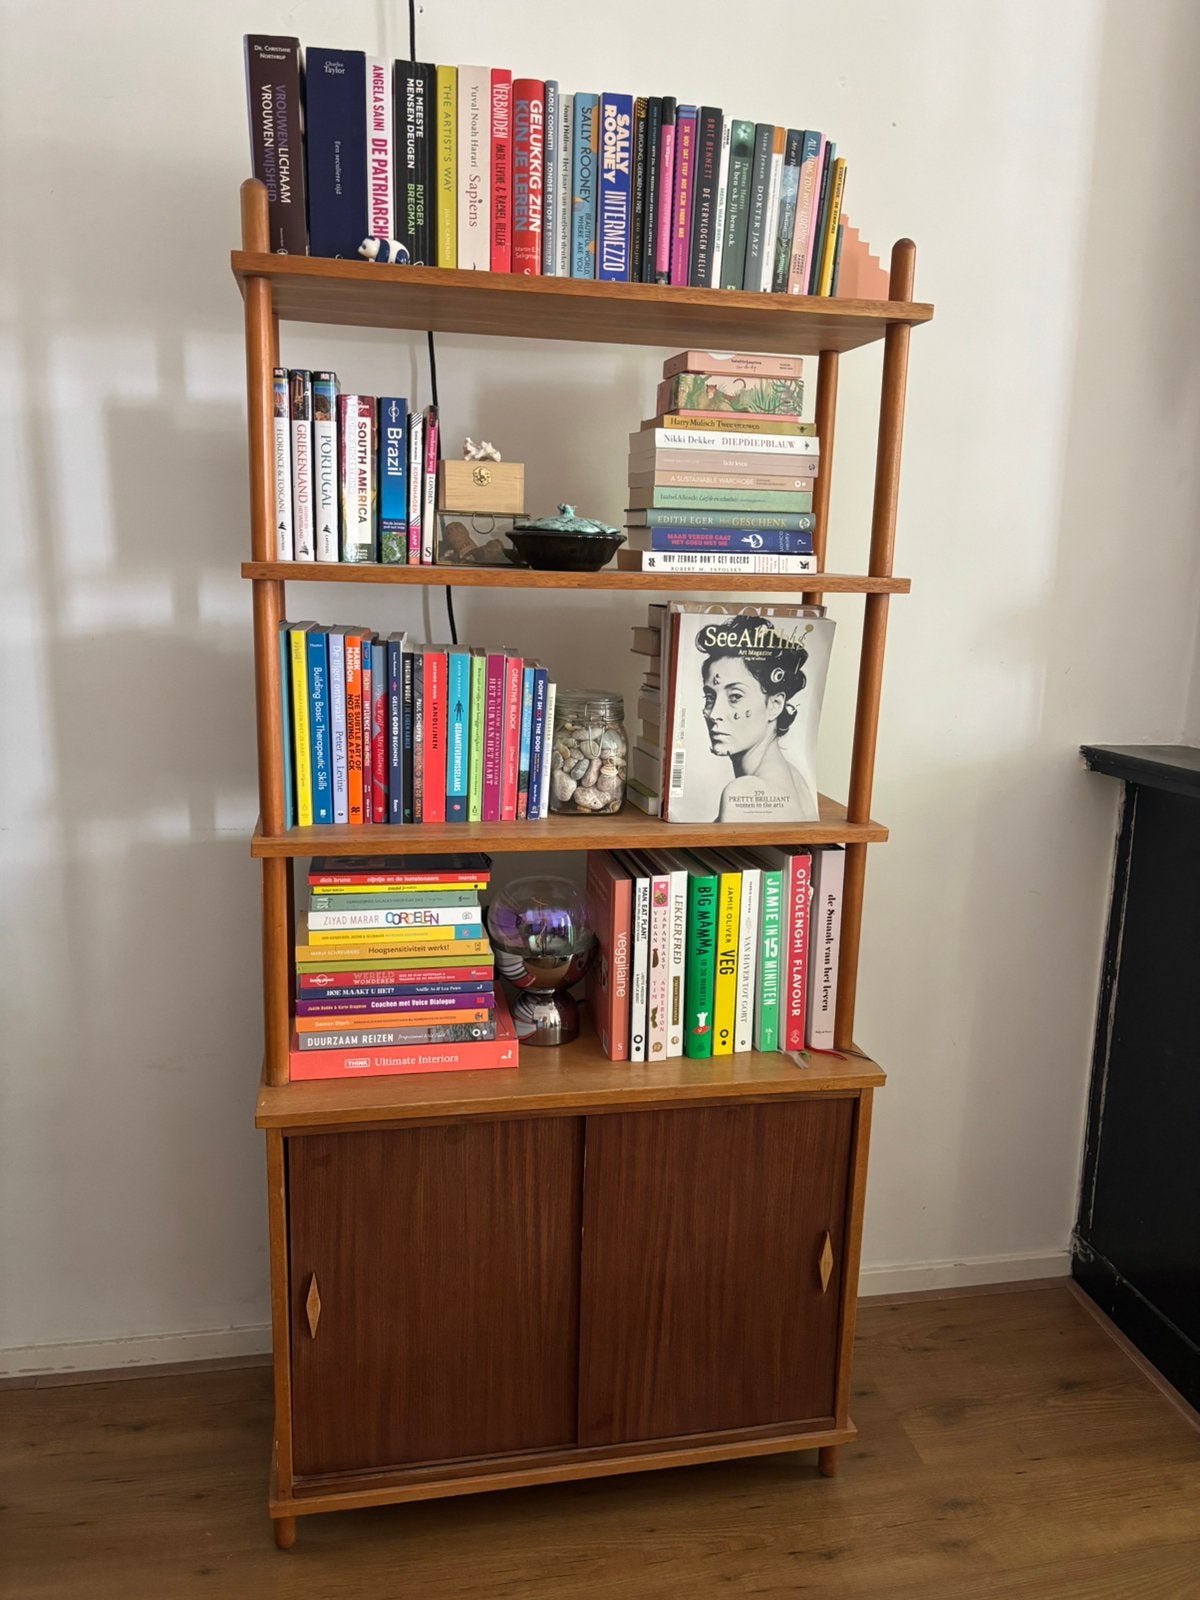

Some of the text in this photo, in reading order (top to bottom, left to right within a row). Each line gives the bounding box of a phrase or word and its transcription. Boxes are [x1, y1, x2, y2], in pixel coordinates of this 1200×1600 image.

[323, 65, 346, 75] Taylor
[372, 65, 385, 132] ANGELA SAINI
[407, 78, 415, 169] MENSEN DEUGEN
[415, 79, 424, 138] DE MEESTE
[470, 85, 479, 168] Yuval Noah Harari
[492, 83, 510, 139] VERBONDEN
[274, 84, 291, 204] VROUWENLICHAAM
[443, 85, 453, 192] THE ARTIST'S WAY
[514, 100, 528, 231] KUN JE LEREN
[528, 100, 543, 233] GELUKKIG ZIJN
[579, 107, 592, 203] SALLY ROONEY
[603, 104, 617, 184] ROONEY
[615, 114, 630, 175] SALLY
[703, 118, 715, 180] BRIT BENNETT
[334, 154, 342, 183] seculiere
[334, 183, 342, 195] tijd
[371, 138, 390, 240] DE PATRIARCHI
[739, 162, 749, 210] Thomas Harris
[407, 183, 415, 235] BREGMAN
[416, 184, 424, 226] RUTGER
[465, 174, 481, 228] Sapiens
[751, 185, 764, 258] DOKTER JAZZ
[602, 190, 627, 272] INTERMEZZO
[697, 188, 711, 279] DE VERVLOGEN HELFT
[387, 427, 402, 476] Brazil
[664, 435, 715, 445] Nikki Dekker
[670, 418, 715, 427] Harry Mulisch
[722, 437, 796, 449] DIEPDIEPBLAUW
[296, 424, 307, 504] GRIEKENLAND
[320, 434, 332, 509] PORTUGAL
[357, 421, 368, 524] SOUTH AMERICA
[411, 466, 419, 514] KOPENHAGEN
[657, 516, 686, 524] EDITH
[732, 518, 788, 528] GESCHENK
[663, 555, 675, 563] WHY
[677, 555, 697, 563] ZEBRAS
[700, 556, 716, 564] DON'T
[717, 556, 728, 564] GET
[729, 556, 750, 565] ULCERS
[346, 647, 354, 683] MANSON
[347, 712, 355, 741] GIVING
[509, 668, 518, 730] CREATIVE BLOCK
[312, 667, 327, 791] Building Basic Therapeutic Skills
[453, 723, 463, 792] GEDAANTEVERWISSELAARS
[335, 731, 345, 793] Peter A. Levine
[354, 760, 362, 771] OF
[323, 915, 380, 926] ZIYAD MARAR
[385, 911, 440, 925] OORDELEN
[640, 919, 648, 942] PLANT.
[695, 886, 714, 956] BIG MAMMA
[763, 878, 779, 1006] JAMIE IN 15 MINUTEN
[791, 869, 806, 1017] OTTOLENGHI FLAVOUR
[368, 944, 449, 956] Hoogsensitiviteit werkt!
[614, 931, 629, 998] veggilaine
[719, 950, 735, 975] VEG
[740, 936, 751, 1023] VAN HAVER TOT GORT
[821, 894, 835, 1012] de Smaak van het leven
[342, 988, 368, 996] MAAKT
[377, 987, 394, 995] HET?
[398, 1000, 410, 1008] met
[412, 999, 428, 1007] Voice
[430, 998, 455, 1006] Dialogue
[307, 1036, 358, 1047] DUURZAAM
[362, 1033, 394, 1044] REIZEN
[375, 1056, 416, 1067] Ultimate
[418, 1054, 460, 1065] Interiors
